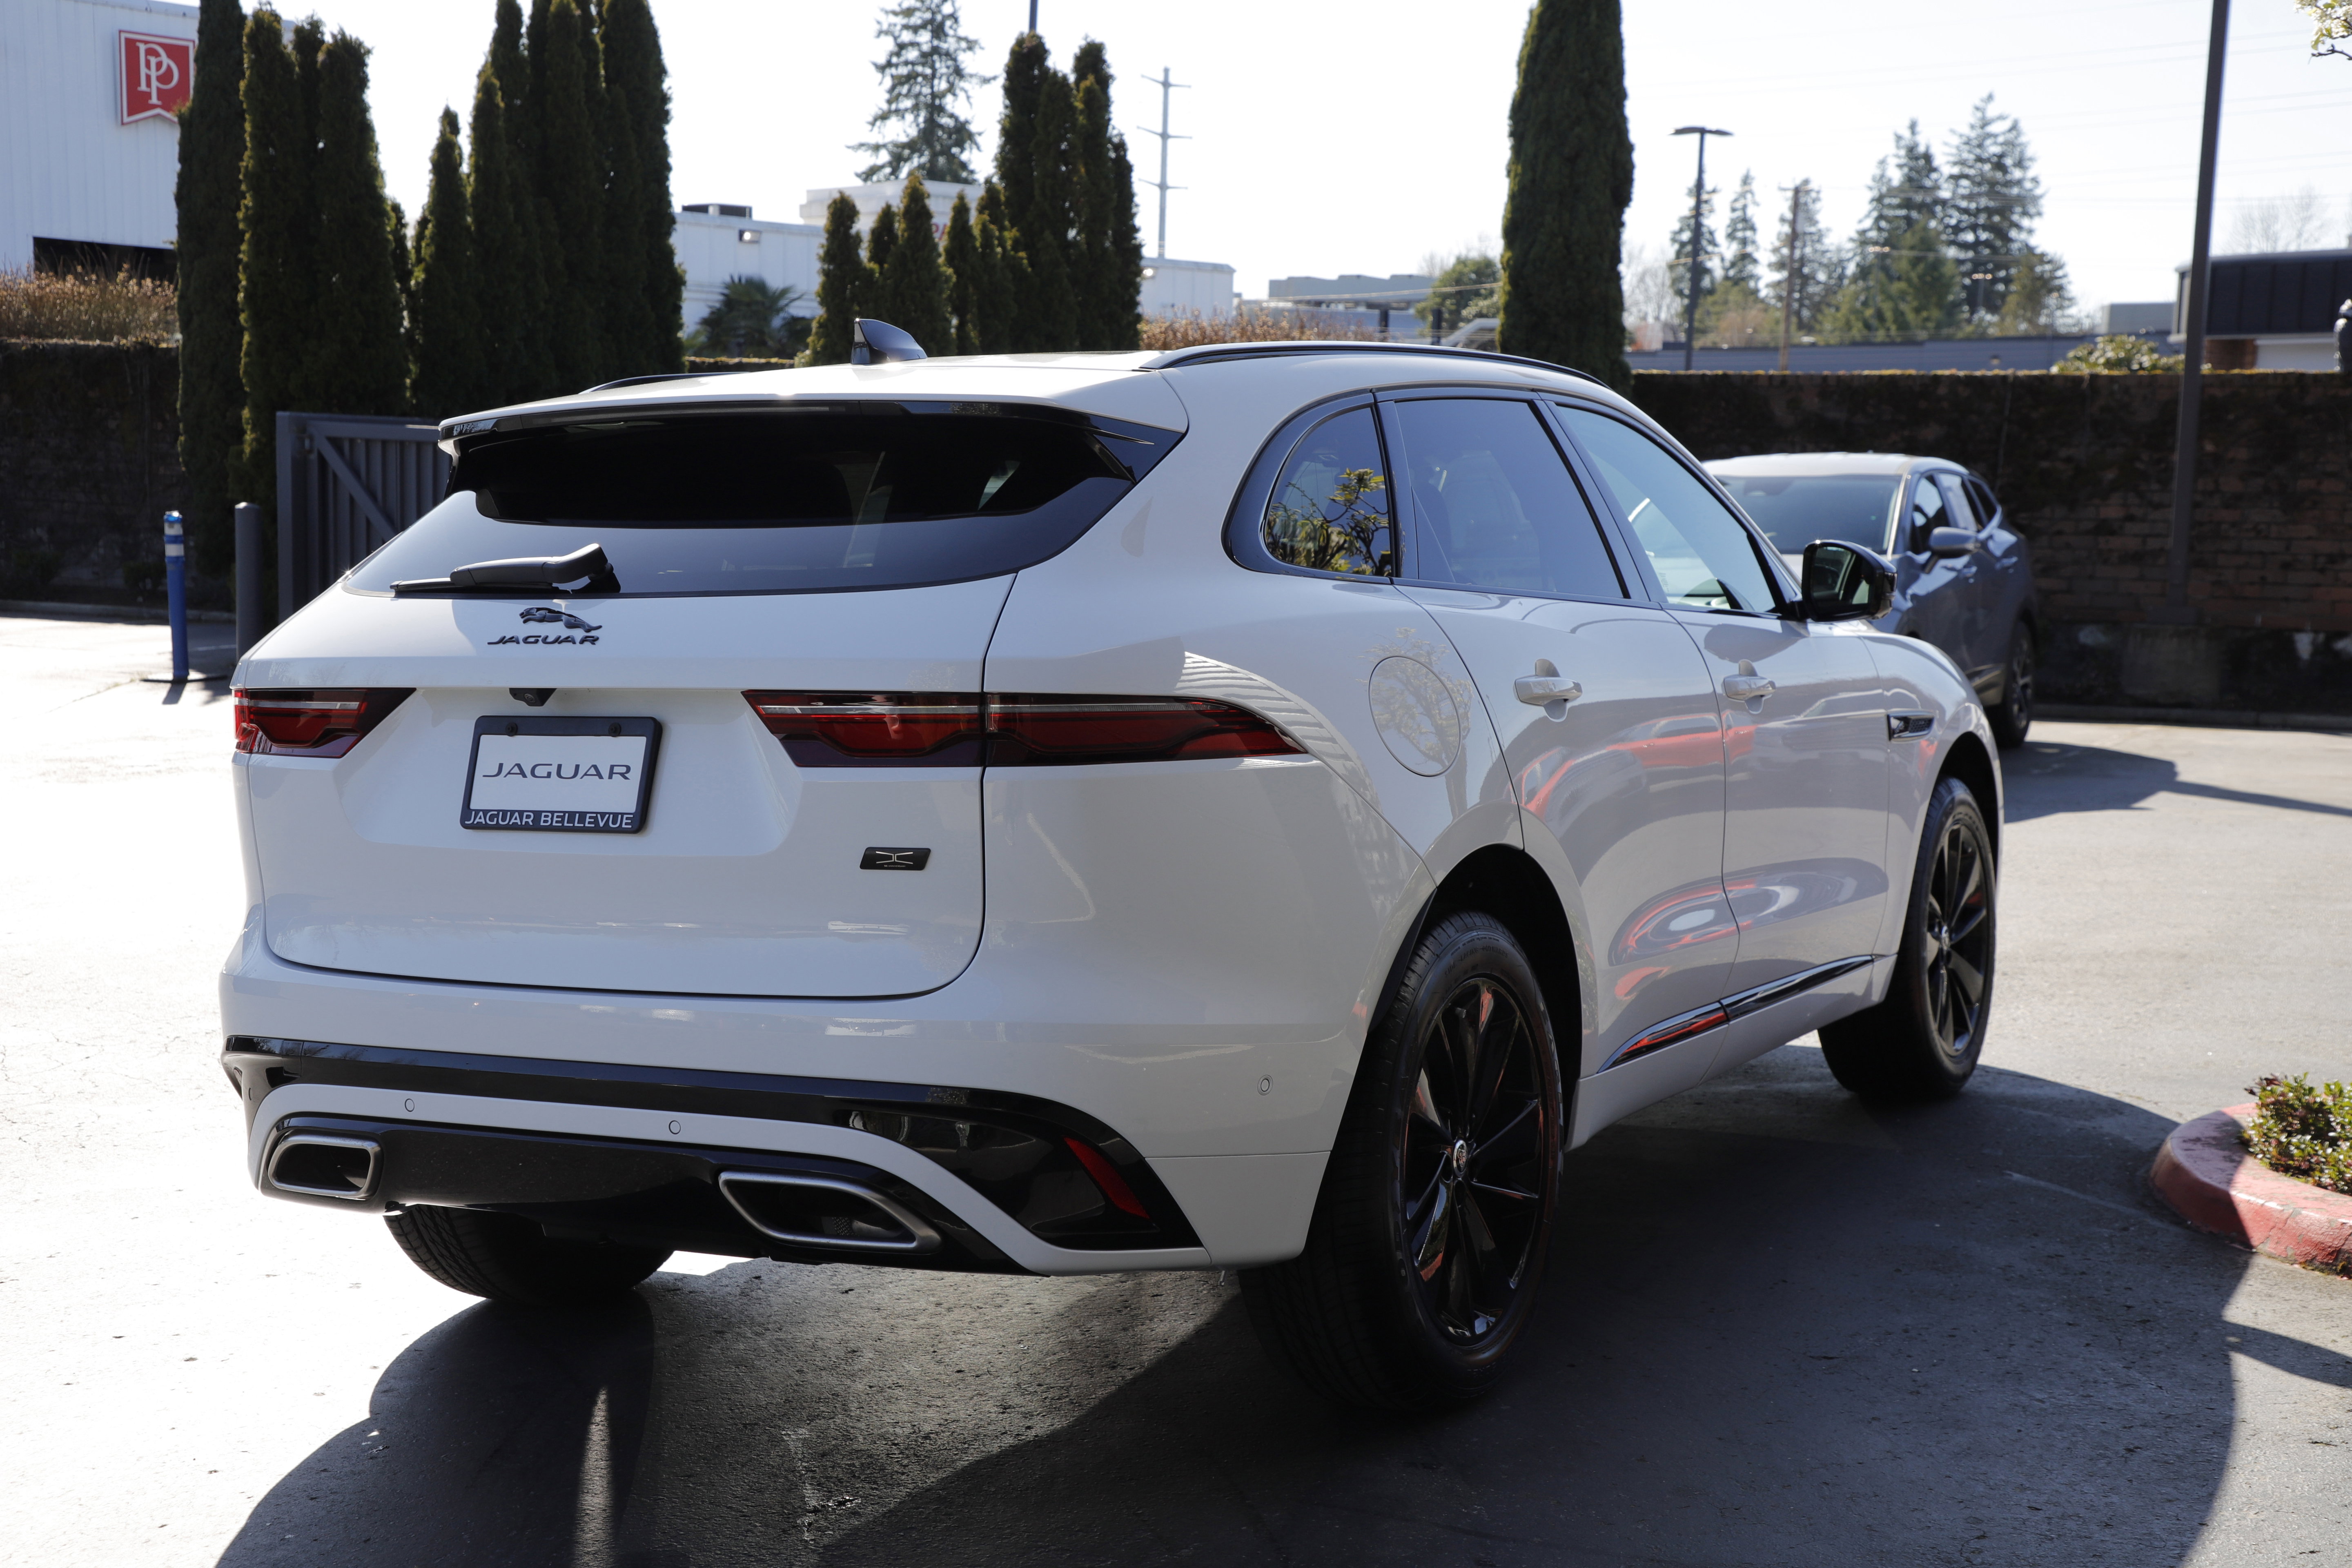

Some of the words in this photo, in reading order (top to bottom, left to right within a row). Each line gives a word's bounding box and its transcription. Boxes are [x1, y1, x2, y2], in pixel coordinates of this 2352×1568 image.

[487, 635, 600, 645] JAGUAR
[482, 762, 632, 780] JAGUAR
[465, 811, 535, 826] JAGUAR
[540, 813, 634, 829] BELLEVUE
